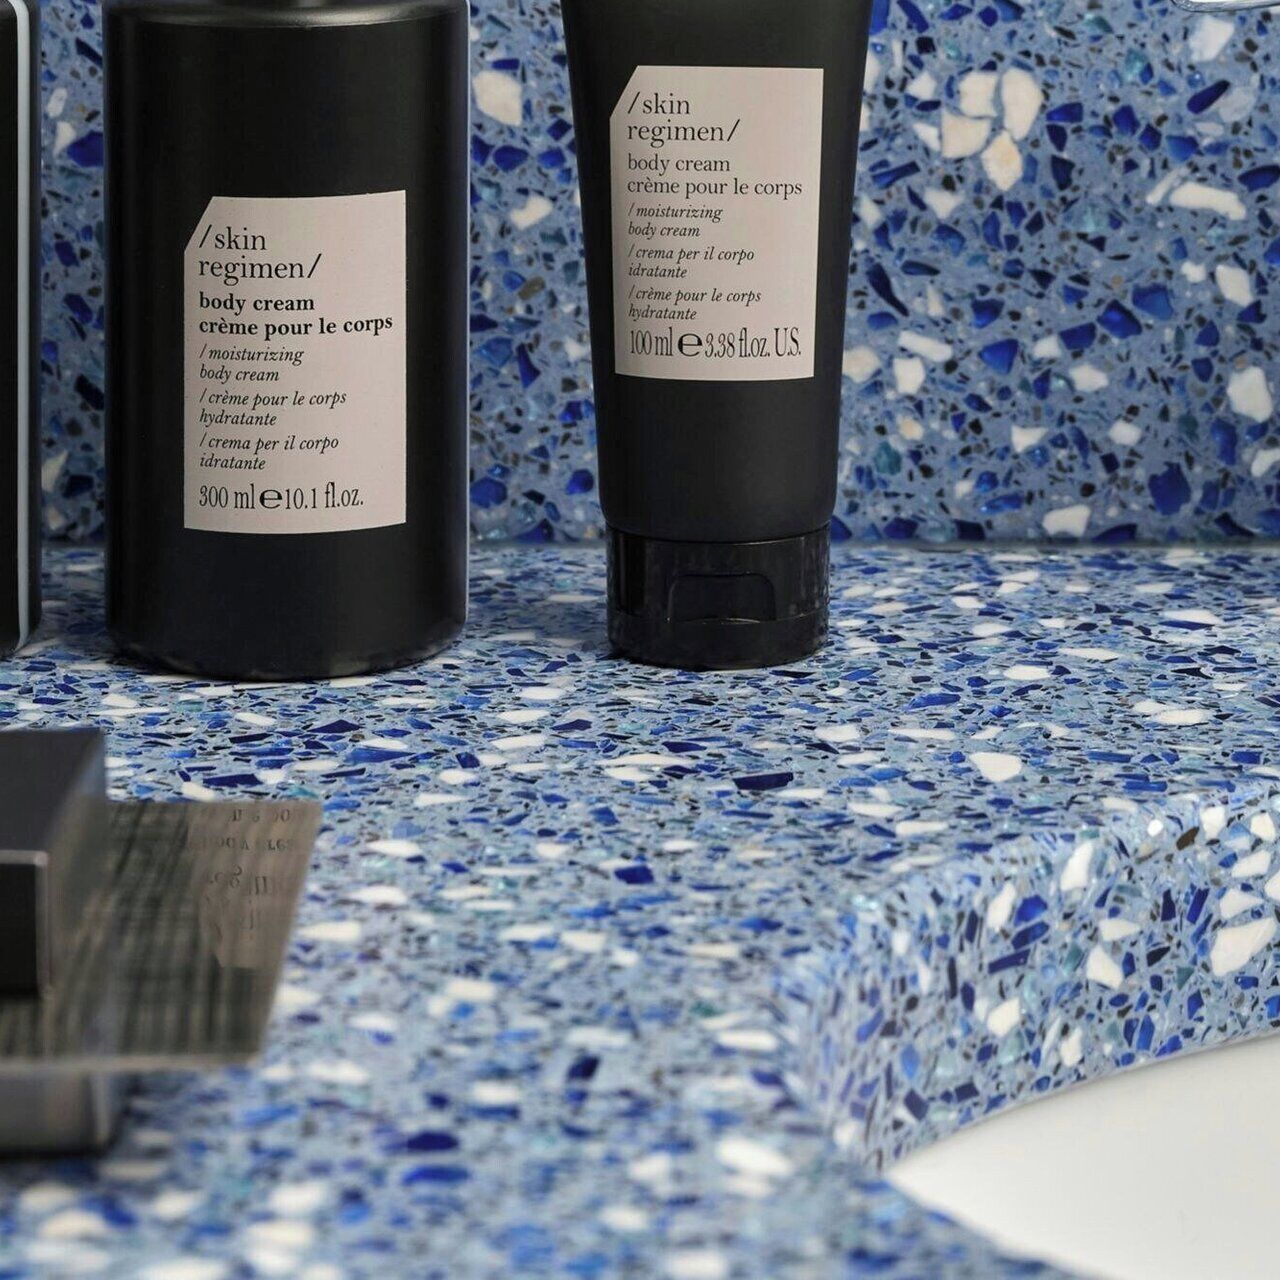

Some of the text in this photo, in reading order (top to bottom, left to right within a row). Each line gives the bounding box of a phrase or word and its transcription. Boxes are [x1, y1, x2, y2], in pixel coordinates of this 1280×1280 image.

[626, 118, 741, 149] regimen/
[626, 152, 730, 177] body cream
[626, 176, 803, 200] crème pour le corps
[627, 222, 701, 241] body cream
[676, 248, 701, 264] per
[703, 245, 715, 261] il
[717, 248, 755, 266] corpo
[198, 253, 322, 287] regimen/
[626, 262, 688, 280] idratante
[199, 290, 315, 317] body cream
[674, 289, 708, 306] pour
[710, 287, 723, 303] le
[726, 290, 762, 306] corps
[626, 304, 698, 323] hydratante
[198, 317, 393, 342] crème pour le corps
[704, 332, 736, 359] 3.38
[199, 364, 279, 384] body cream
[251, 393, 289, 411] pour
[292, 390, 306, 406] le
[308, 391, 347, 410] corps
[198, 408, 277, 429] hydratante
[254, 437, 280, 455] per
[283, 434, 296, 451] il
[299, 436, 339, 455] corpo
[199, 452, 266, 471] idratante
[198, 484, 229, 509] 300
